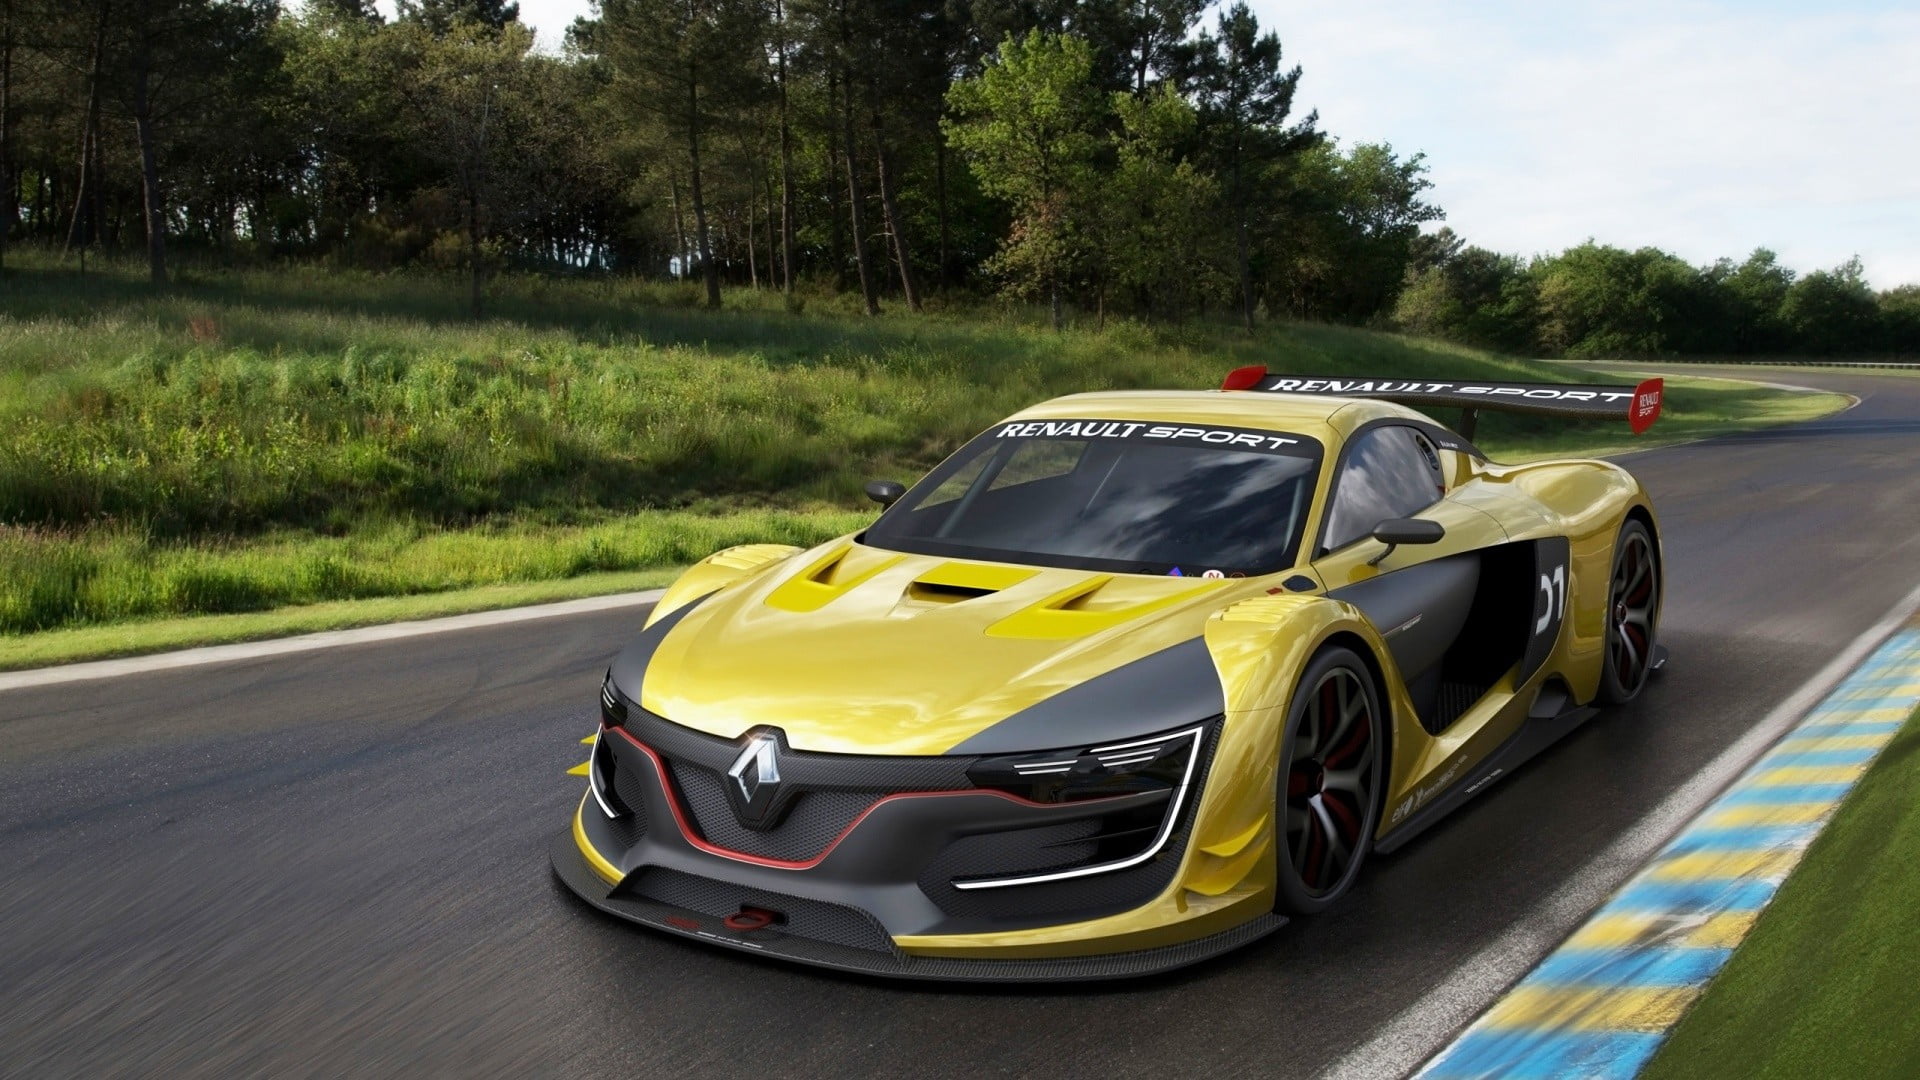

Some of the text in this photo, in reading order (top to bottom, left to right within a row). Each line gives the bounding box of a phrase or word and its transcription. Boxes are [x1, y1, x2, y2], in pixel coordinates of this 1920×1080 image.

[1267, 379, 1635, 402] RENAULT SPORT
[996, 422, 1299, 450] RENAULT SPORT
